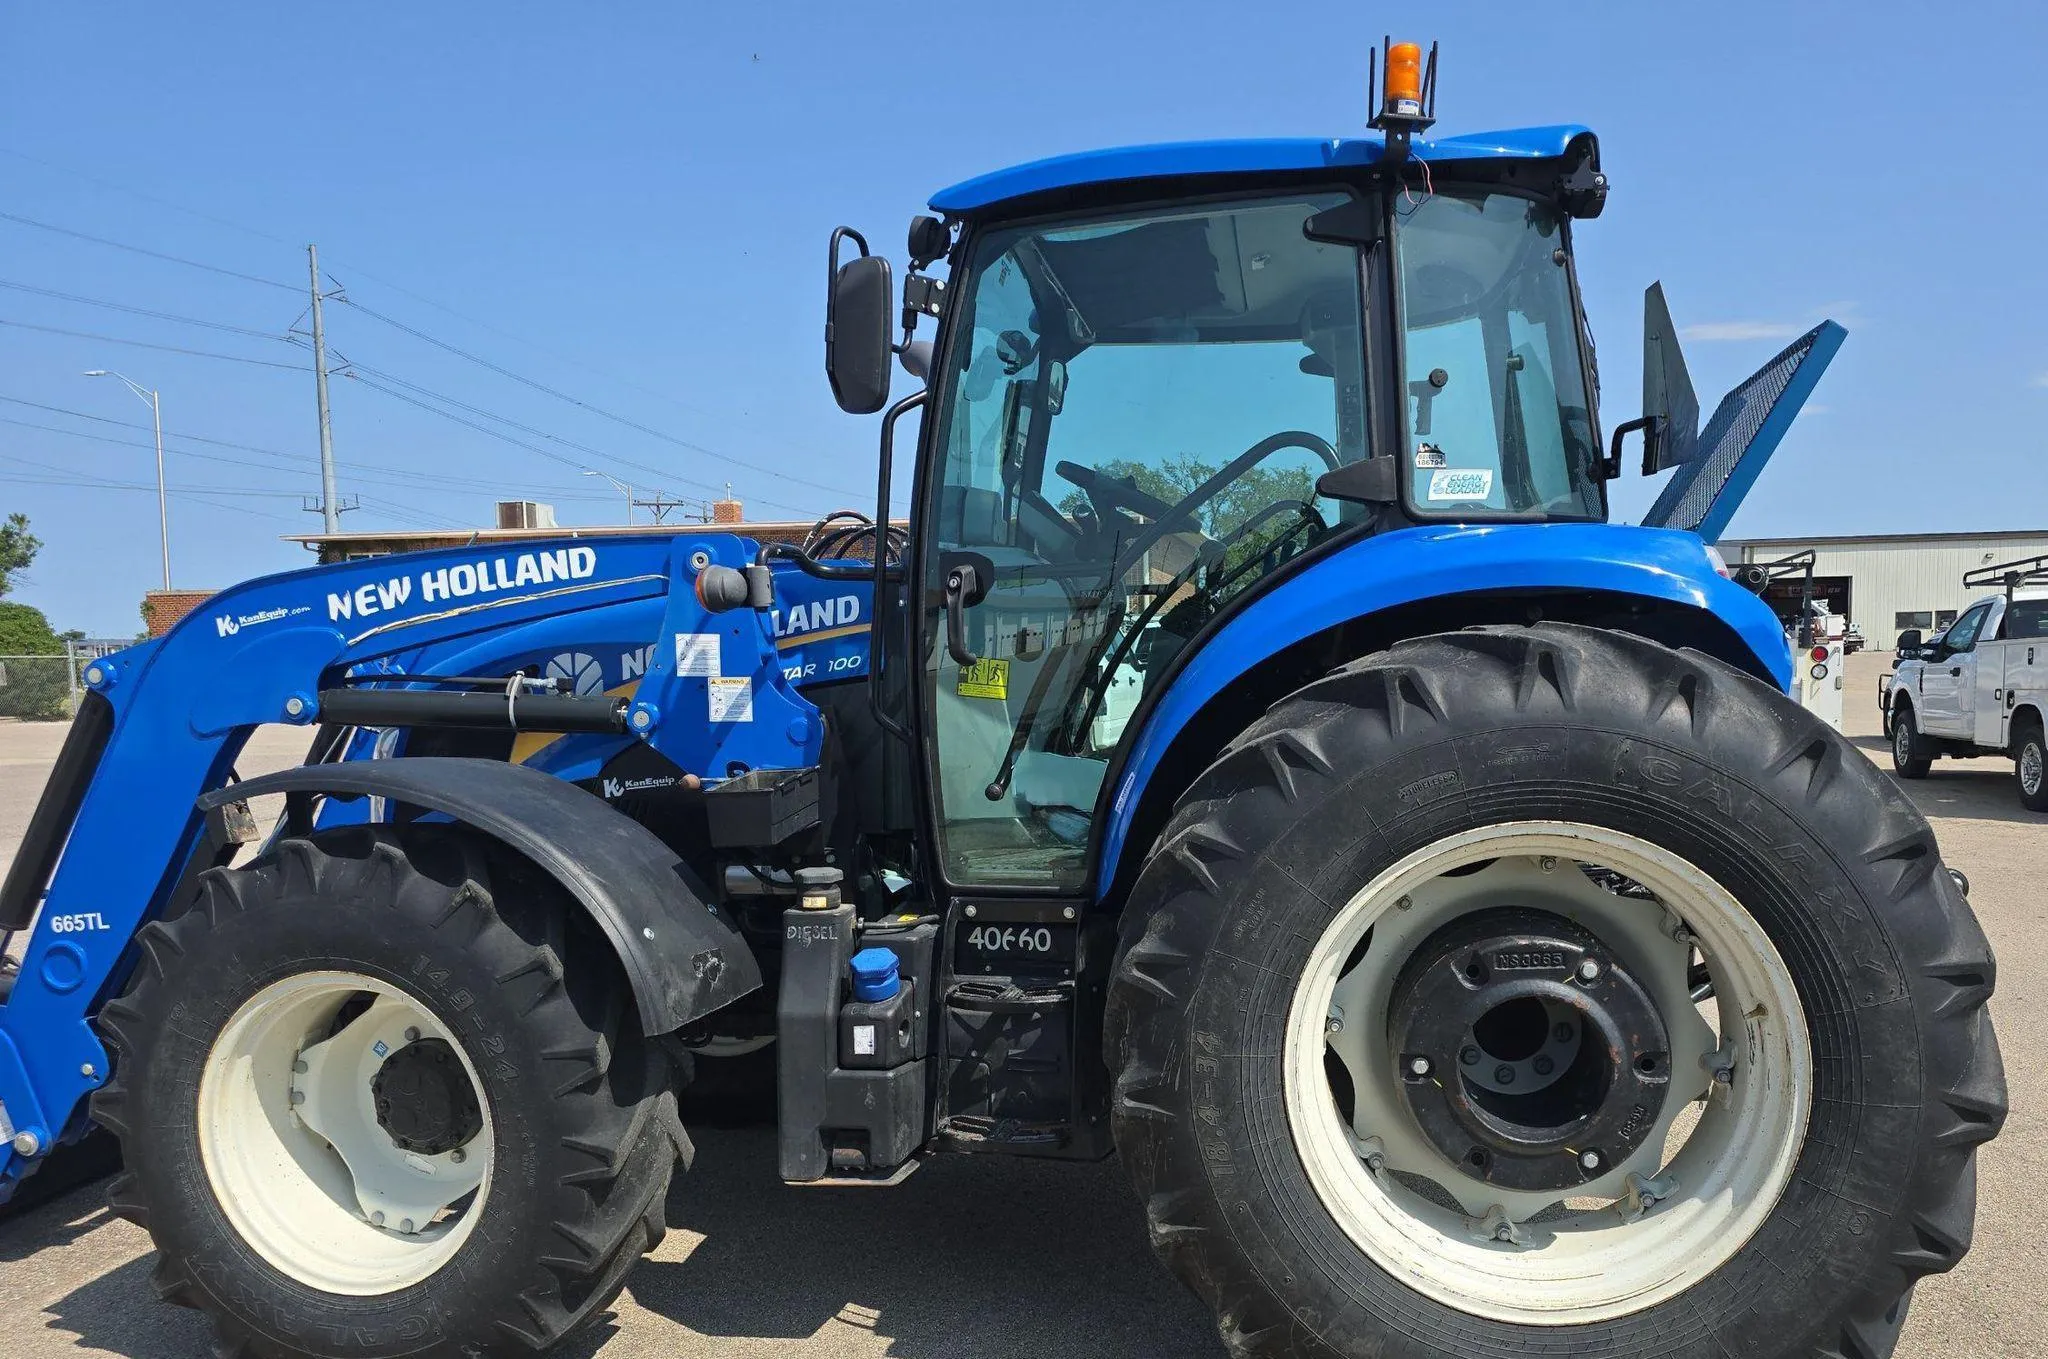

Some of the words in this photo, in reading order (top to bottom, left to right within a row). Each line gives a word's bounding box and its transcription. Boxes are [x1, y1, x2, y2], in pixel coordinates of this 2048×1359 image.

[326, 576, 411, 622] NEW
[421, 546, 597, 602] HOLLAND
[771, 595, 860, 637] LAND
[782, 663, 817, 680] TAR
[828, 656, 862, 673] 100
[1639, 755, 1889, 976] GALAXY
[51, 912, 111, 934] 665TL
[411, 954, 521, 1084] 14.9-24
[1194, 1029, 1237, 1178] 18.4-34
[195, 1259, 430, 1347] GALAXY
